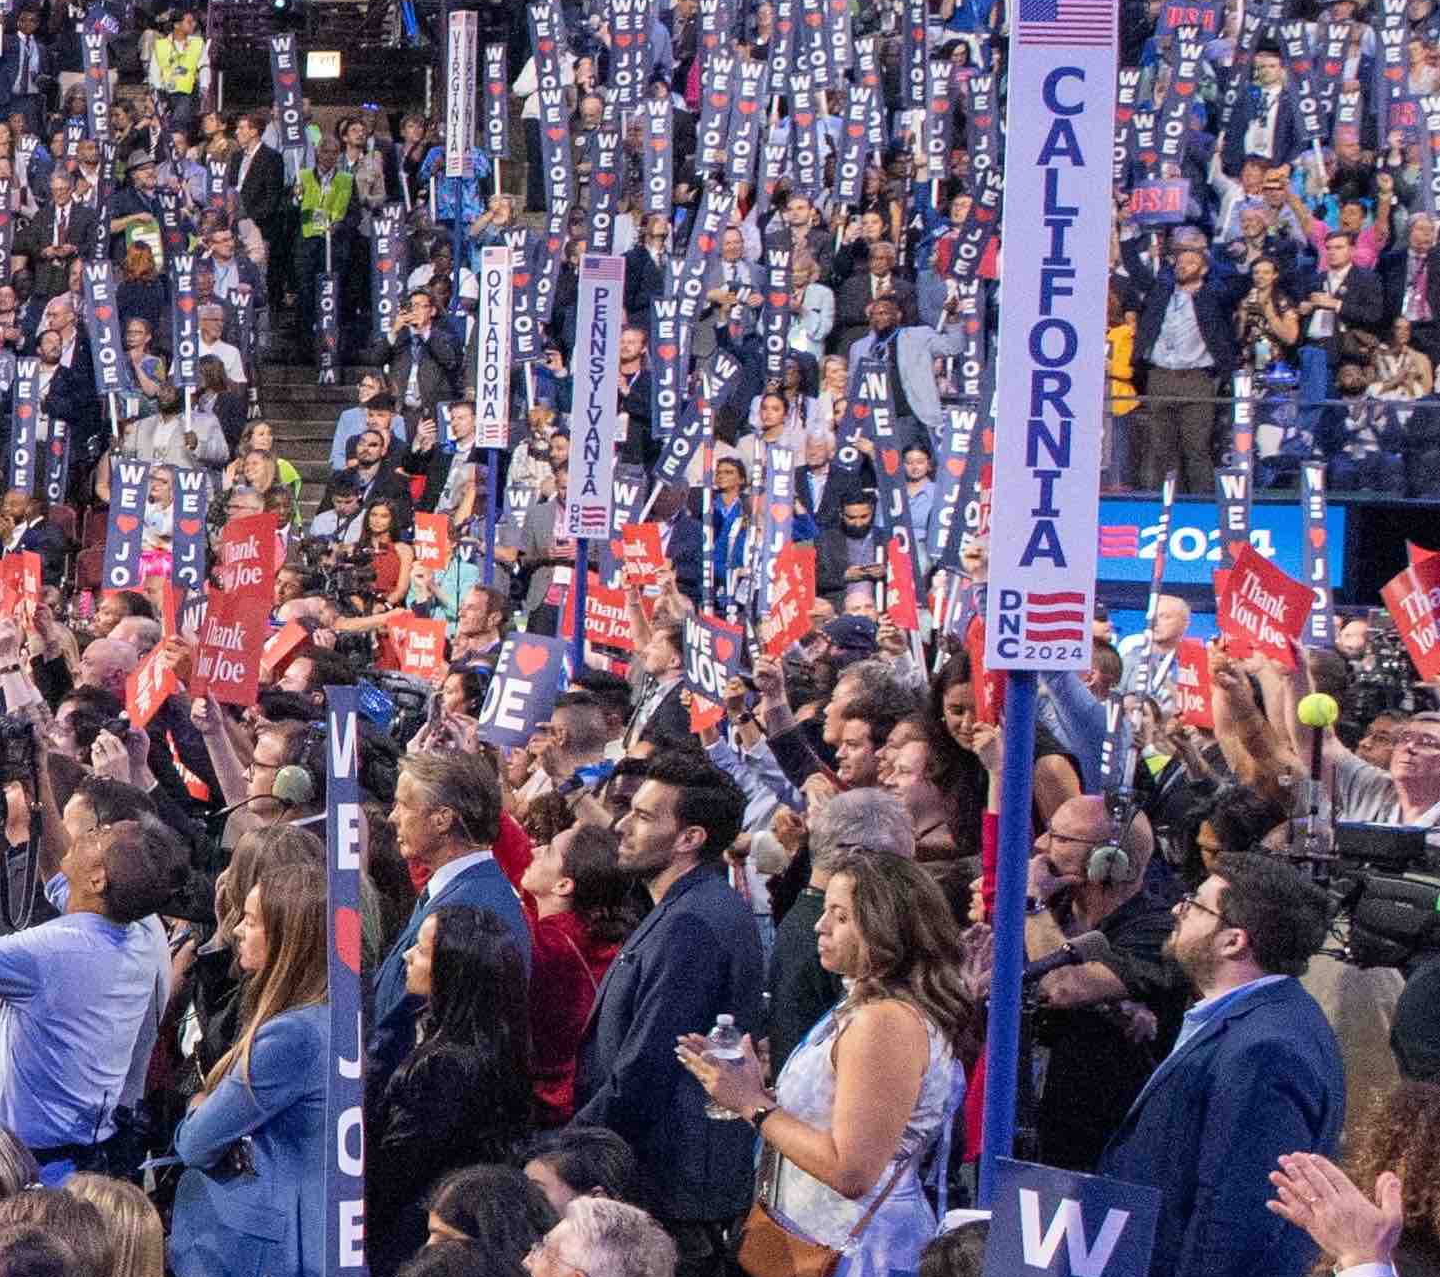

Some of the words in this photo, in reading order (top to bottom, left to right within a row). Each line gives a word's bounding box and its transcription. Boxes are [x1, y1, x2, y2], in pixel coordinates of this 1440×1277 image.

[488, 46, 504, 79] WE
[450, 29, 461, 153] VIRGINIA
[489, 103, 503, 150] JOE
[86, 264, 109, 301] WE
[99, 328, 119, 383] JOE
[483, 270, 501, 419] OKLAHOMA
[656, 301, 677, 338] WE
[1019, 67, 1086, 568] CALIFORNIA
[581, 287, 609, 496] PENNSYLVANIA
[659, 368, 676, 428] JOE
[233, 565, 263, 588] Joe
[1240, 569, 1288, 623] Thank
[206, 616, 246, 651] Thank
[686, 617, 712, 656] WE
[997, 589, 1022, 659] DNC
[1229, 592, 1257, 629] You
[1256, 615, 1287, 649] Joe
[213, 651, 246, 683] Joe
[1024, 646, 1084, 660] 2024
